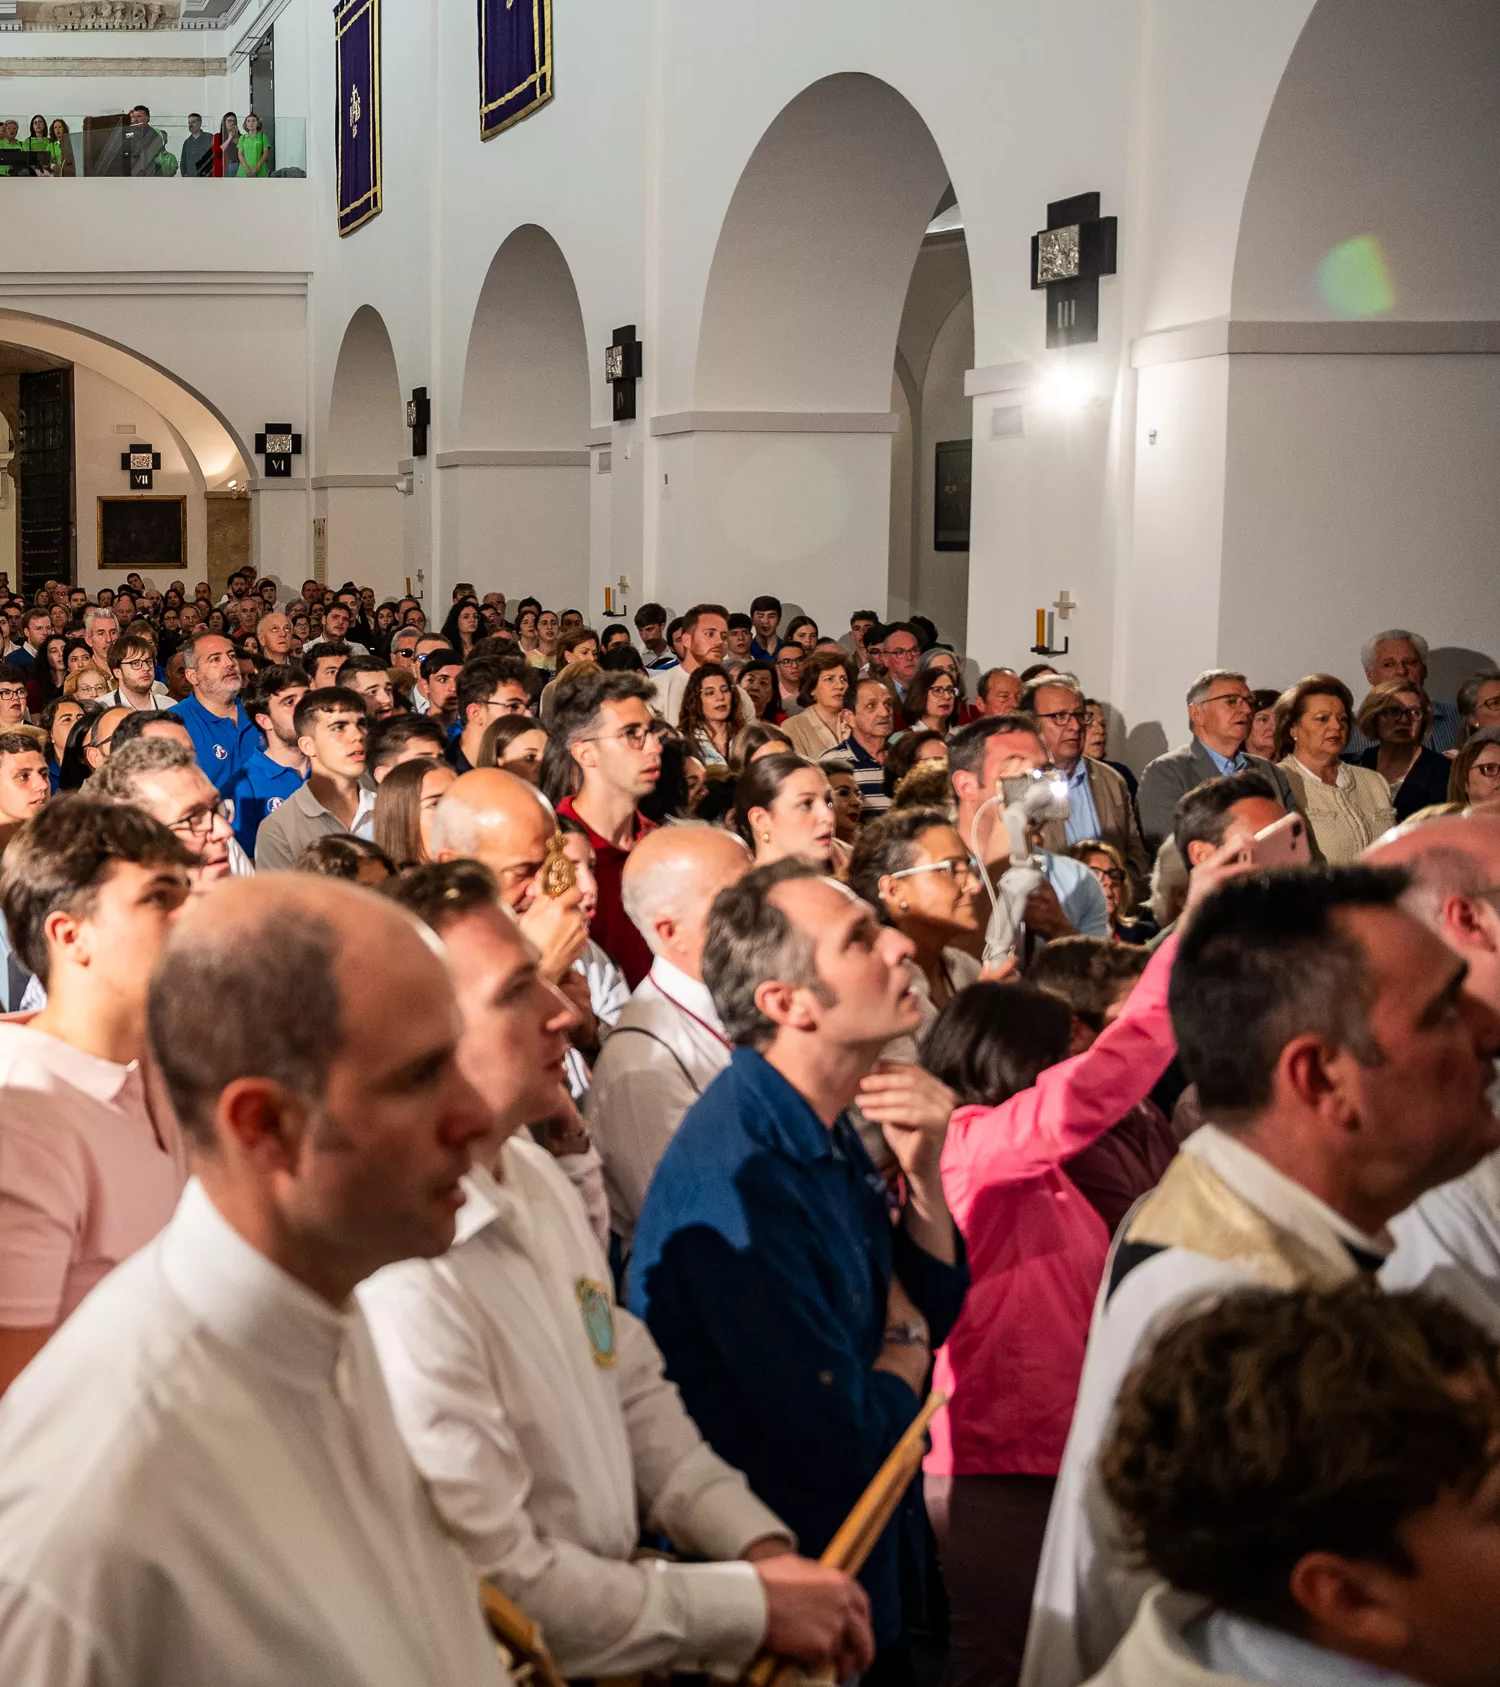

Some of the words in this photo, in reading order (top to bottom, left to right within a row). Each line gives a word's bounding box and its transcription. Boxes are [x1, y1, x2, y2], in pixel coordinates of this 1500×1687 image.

[1057, 299, 1075, 329] III
[272, 459, 284, 471] VI
[135, 474, 148, 485] VII
